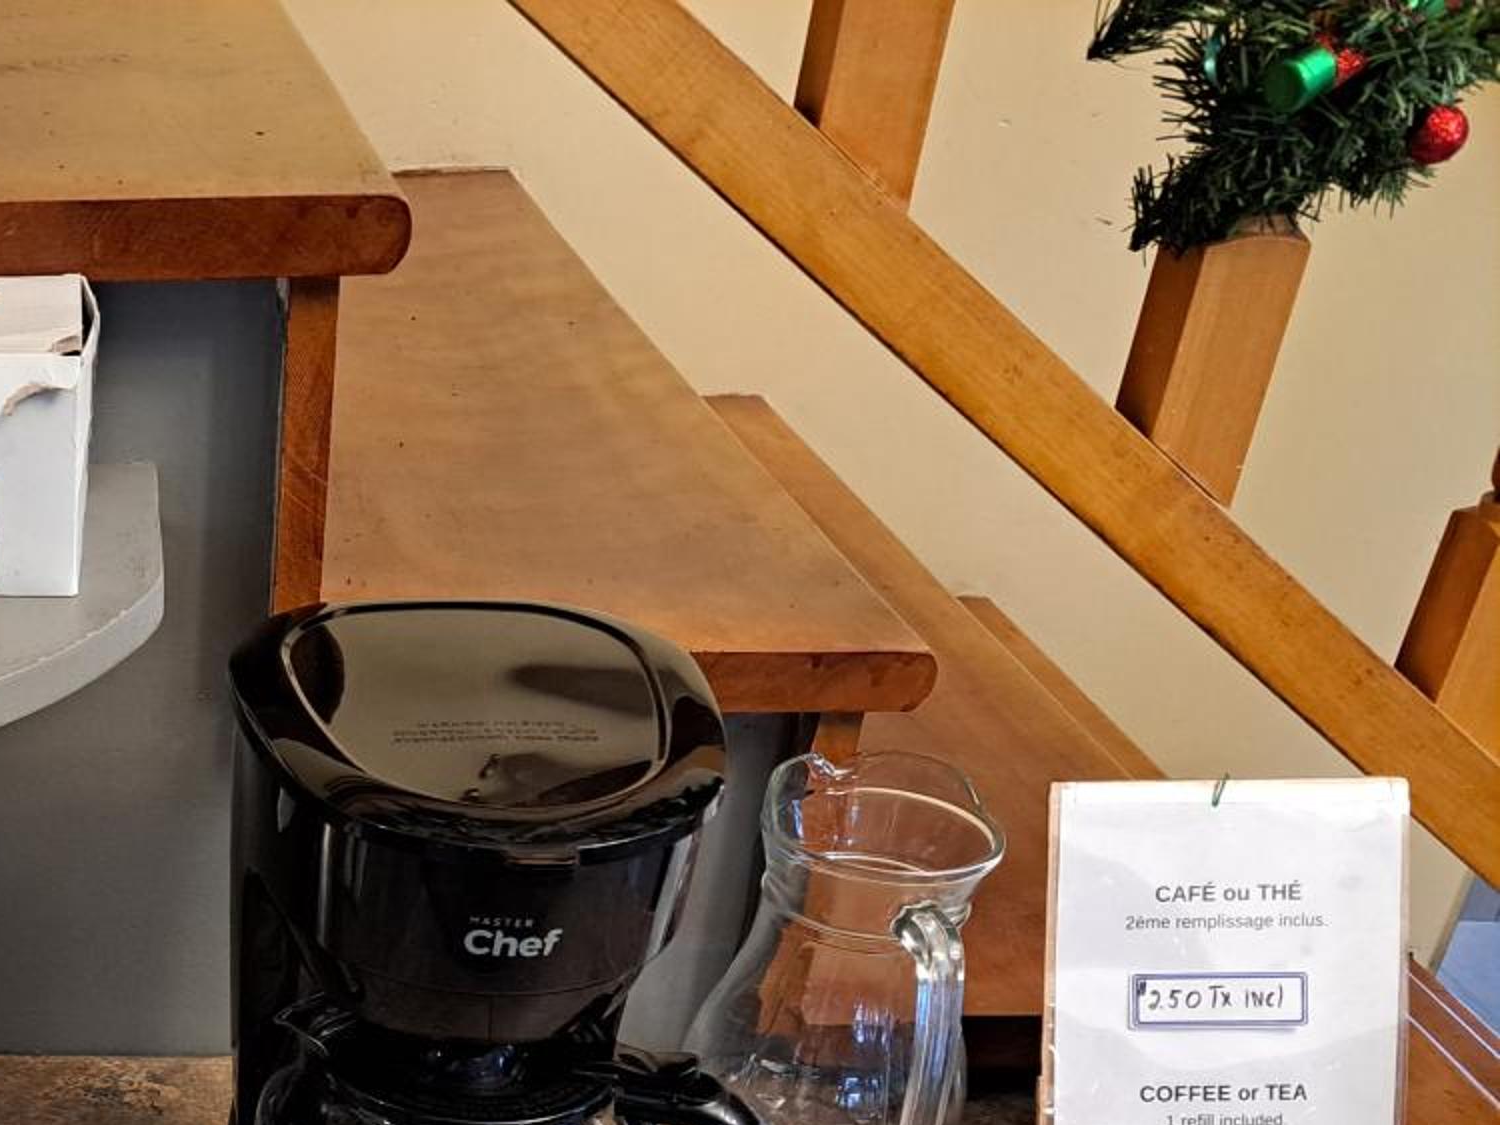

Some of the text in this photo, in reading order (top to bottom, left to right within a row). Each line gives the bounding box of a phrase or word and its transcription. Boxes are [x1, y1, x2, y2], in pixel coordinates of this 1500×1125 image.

[1154, 880, 1302, 903] CAFÉ ou THÉ
[1175, 913, 1274, 933] remplissage
[463, 928, 564, 957] Chef
[1139, 1083, 1308, 1103] COFFEE or TEA
